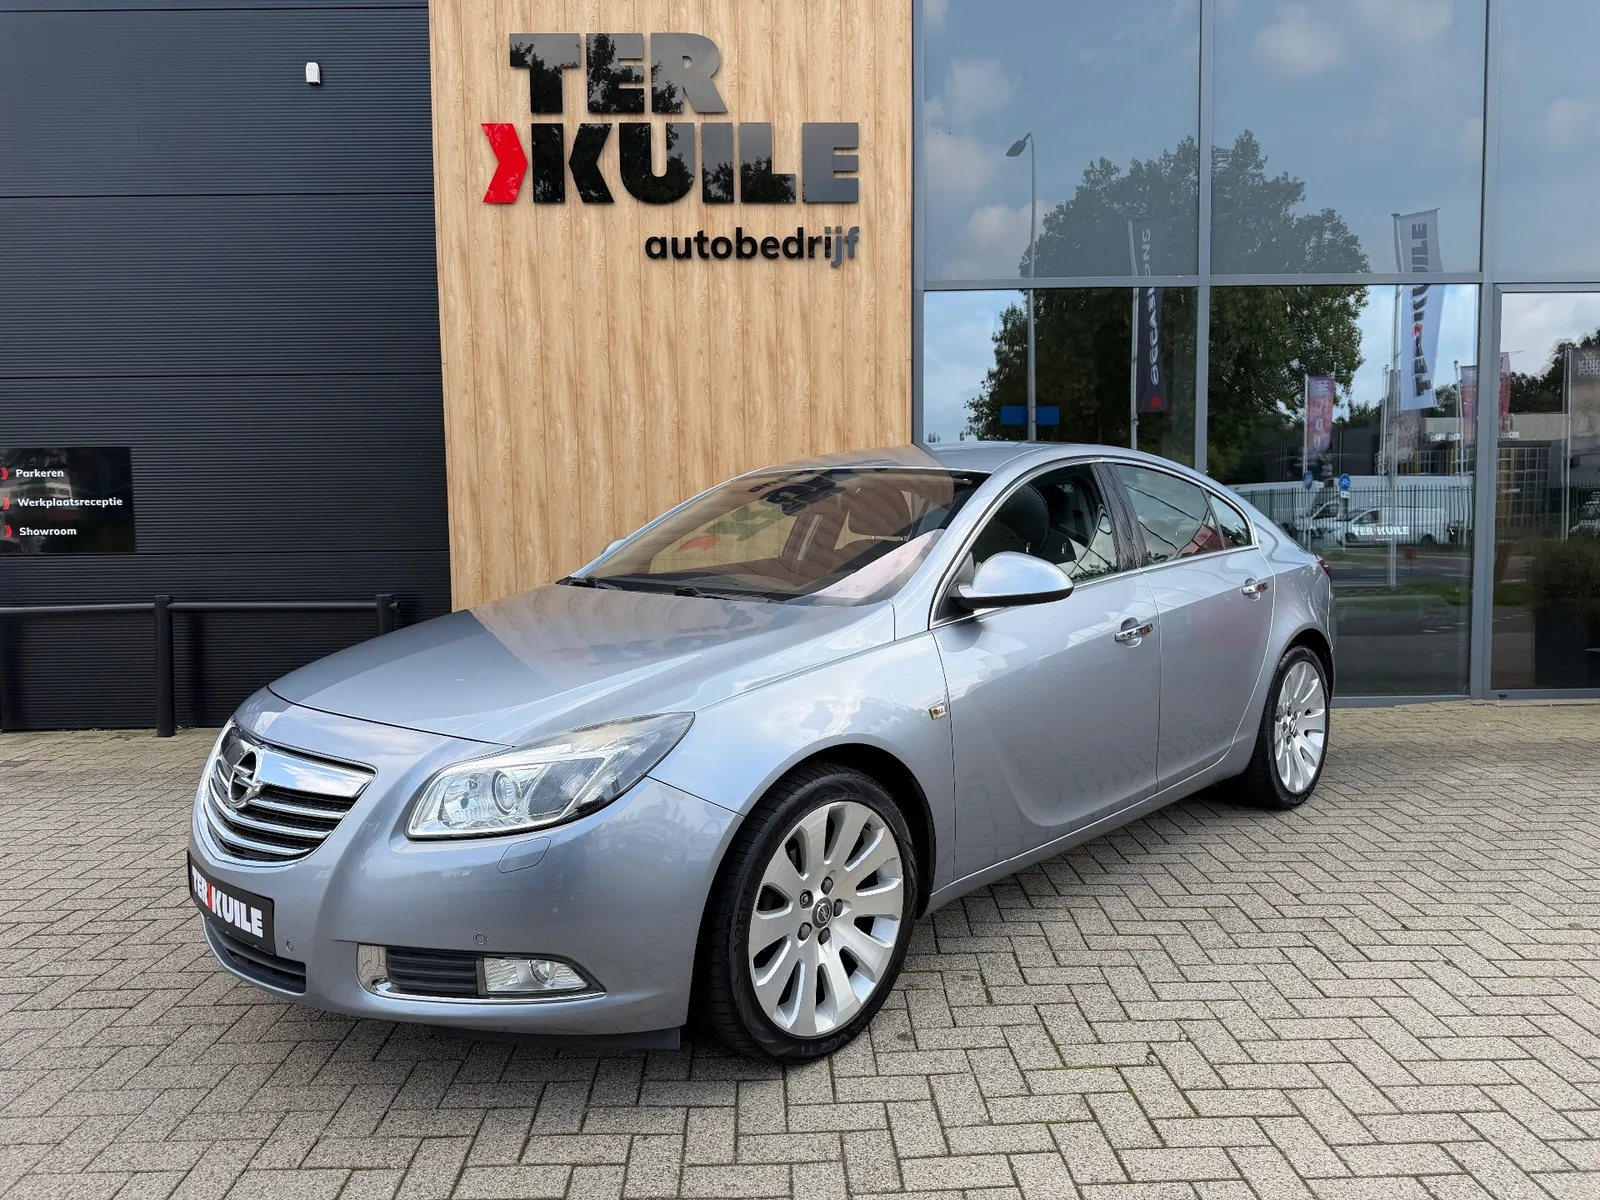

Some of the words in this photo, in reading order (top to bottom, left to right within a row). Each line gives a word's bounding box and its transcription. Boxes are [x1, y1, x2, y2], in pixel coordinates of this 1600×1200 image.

[509, 33, 728, 114] TER
[531, 122, 859, 204] KUILE
[645, 226, 860, 268] autobedrijf
[15, 469, 64, 478] Parkeren
[17, 497, 123, 508] Werkplaatsreceptie
[19, 527, 77, 536] Showroom
[1352, 526, 1375, 536] TER
[1377, 526, 1410, 535] KUILE
[192, 865, 209, 907] TER
[211, 886, 264, 938] KUILE
